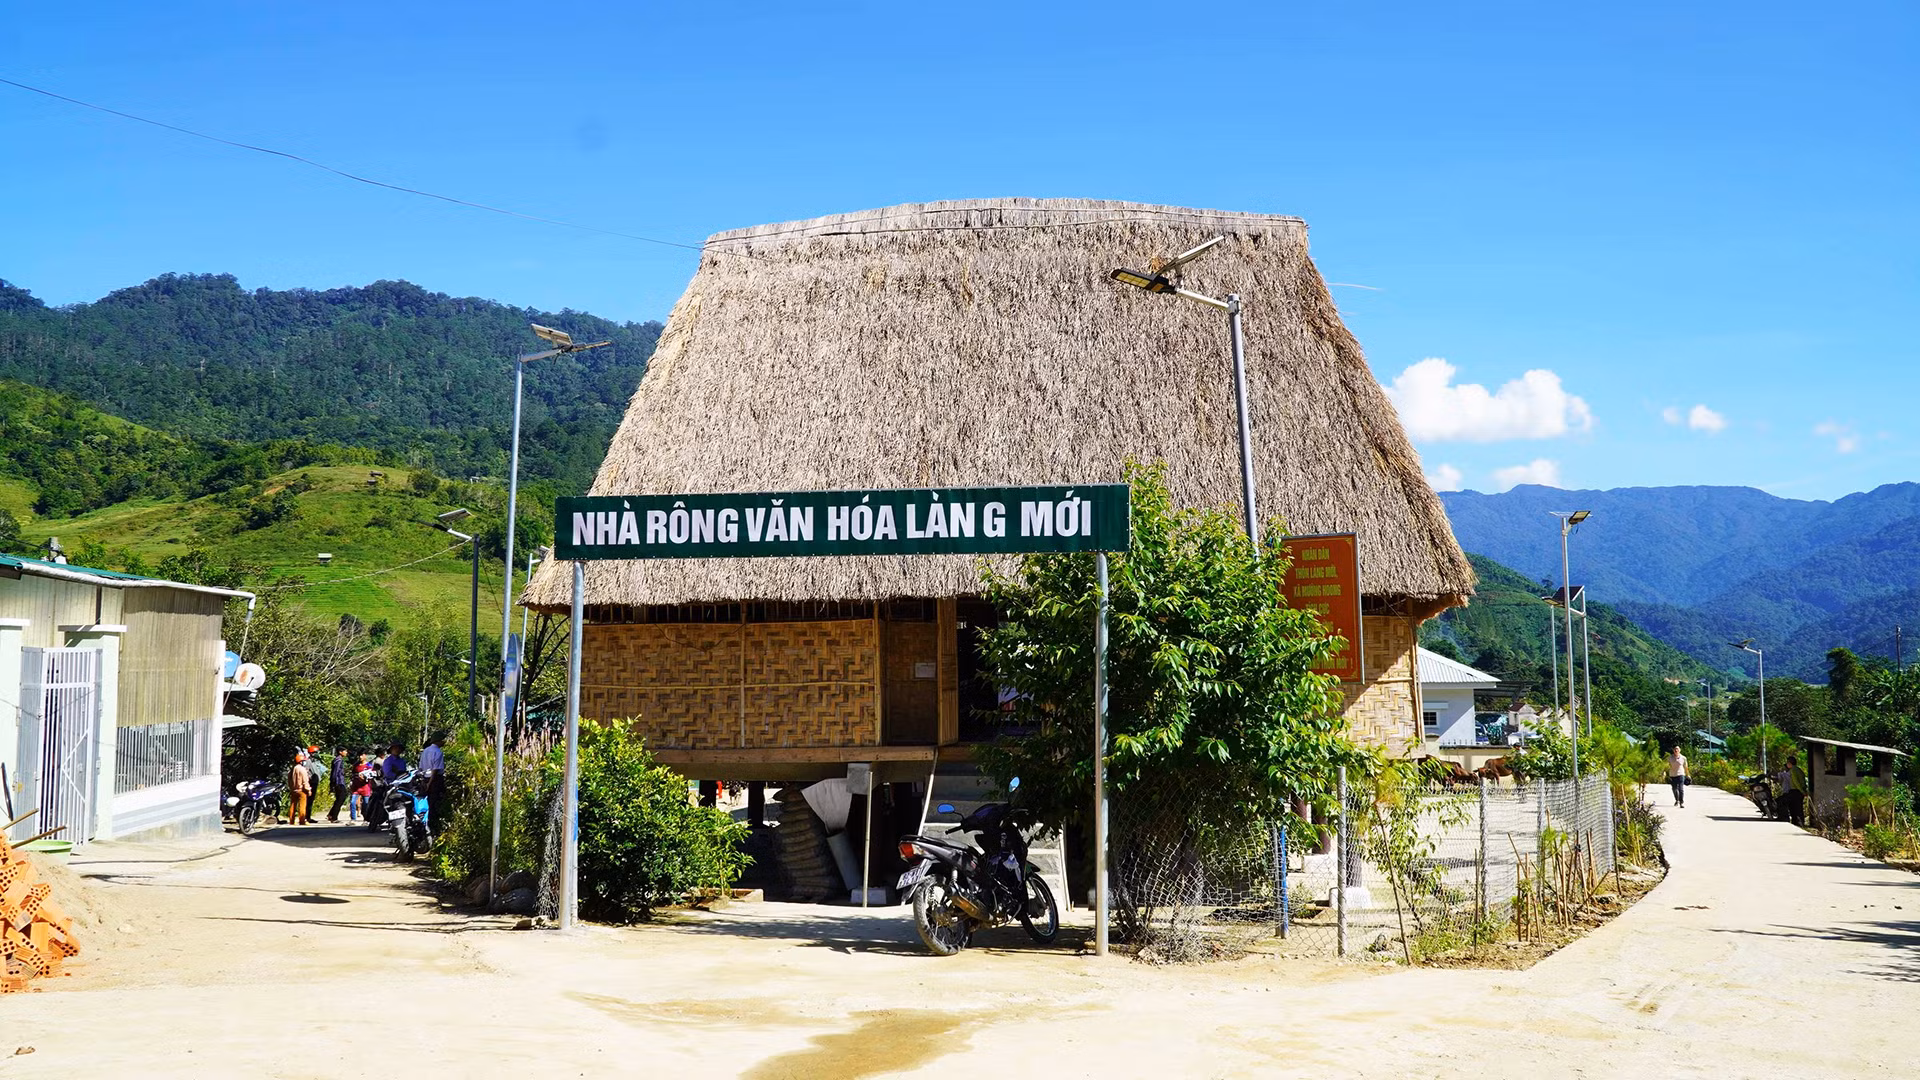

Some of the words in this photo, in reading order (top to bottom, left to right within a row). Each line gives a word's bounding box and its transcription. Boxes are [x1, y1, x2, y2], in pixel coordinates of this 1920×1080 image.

[572, 500, 640, 546] NHÀ
[646, 501, 739, 544] RÔNG
[745, 499, 814, 542] VĂN
[827, 494, 898, 541] HÓA
[1020, 490, 1092, 537] MỚI
